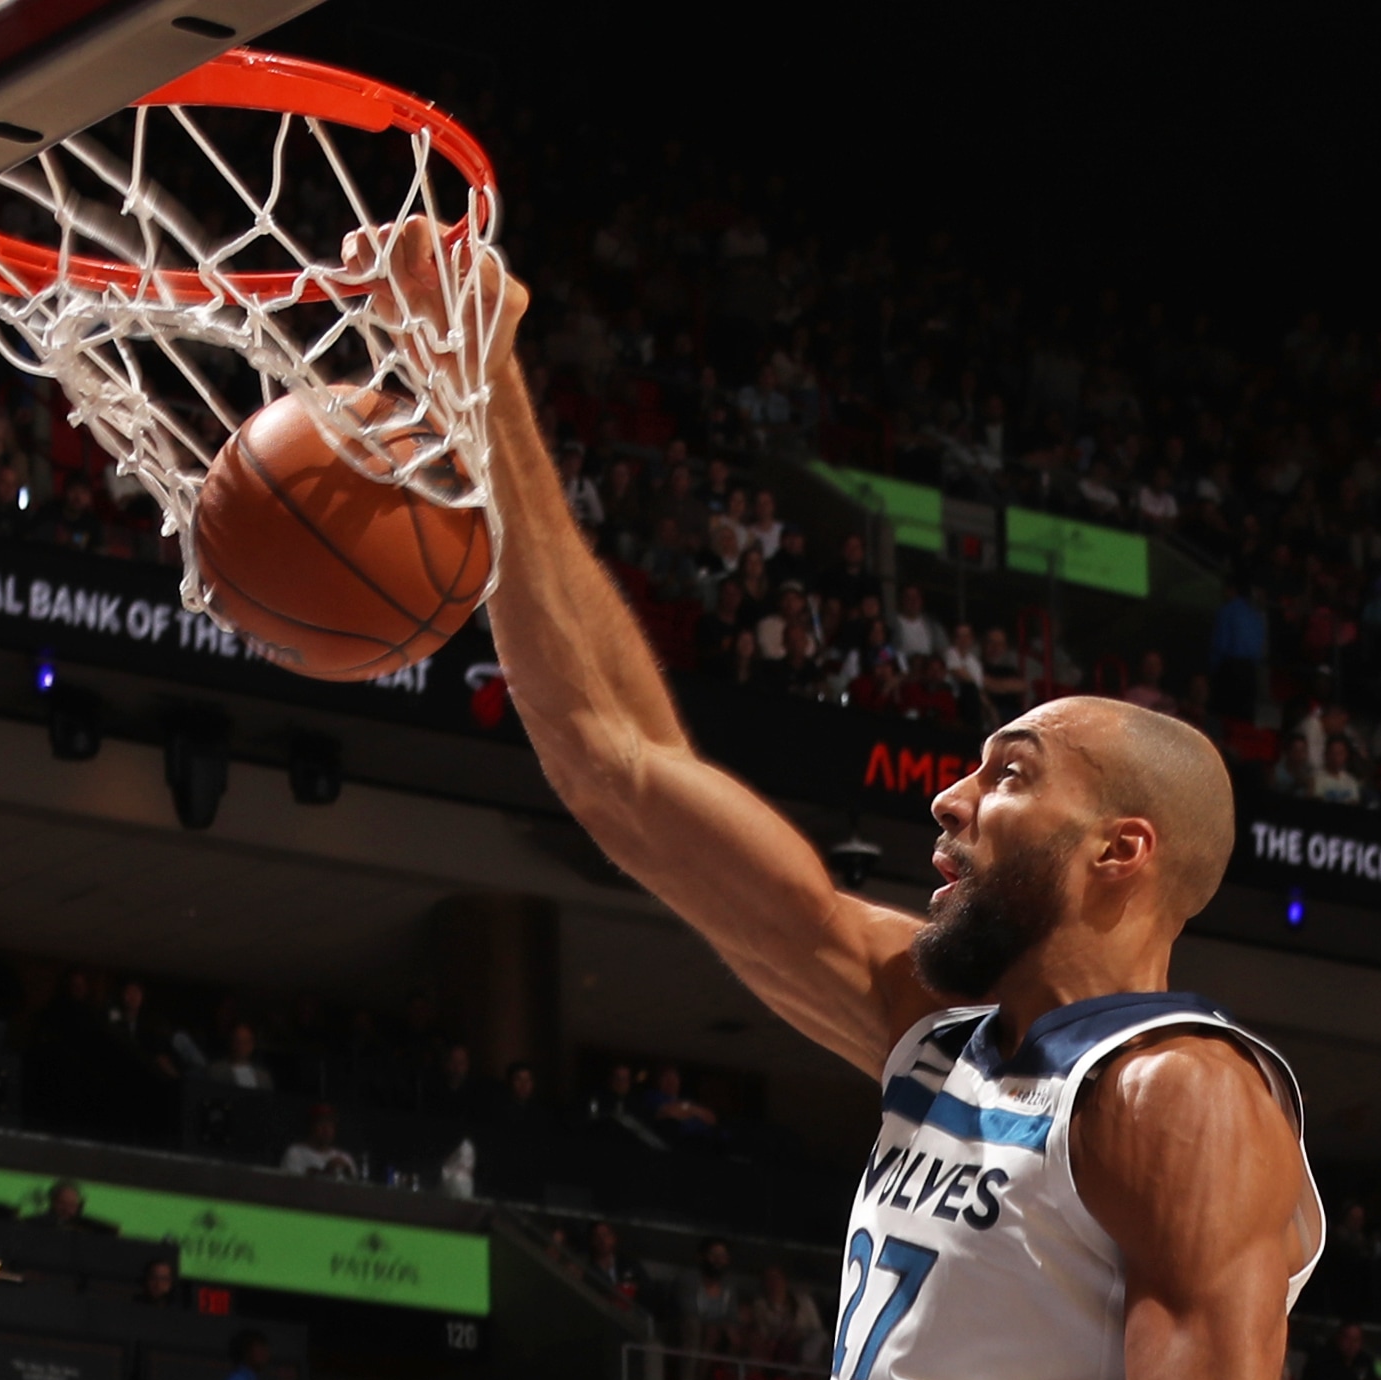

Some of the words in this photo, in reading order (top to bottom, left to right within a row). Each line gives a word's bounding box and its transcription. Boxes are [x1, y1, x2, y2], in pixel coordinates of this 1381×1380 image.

[28, 580, 121, 635] BANK
[126, 600, 169, 645] OF
[1252, 822, 1303, 865] THE
[446, 1321, 478, 1350] 120
